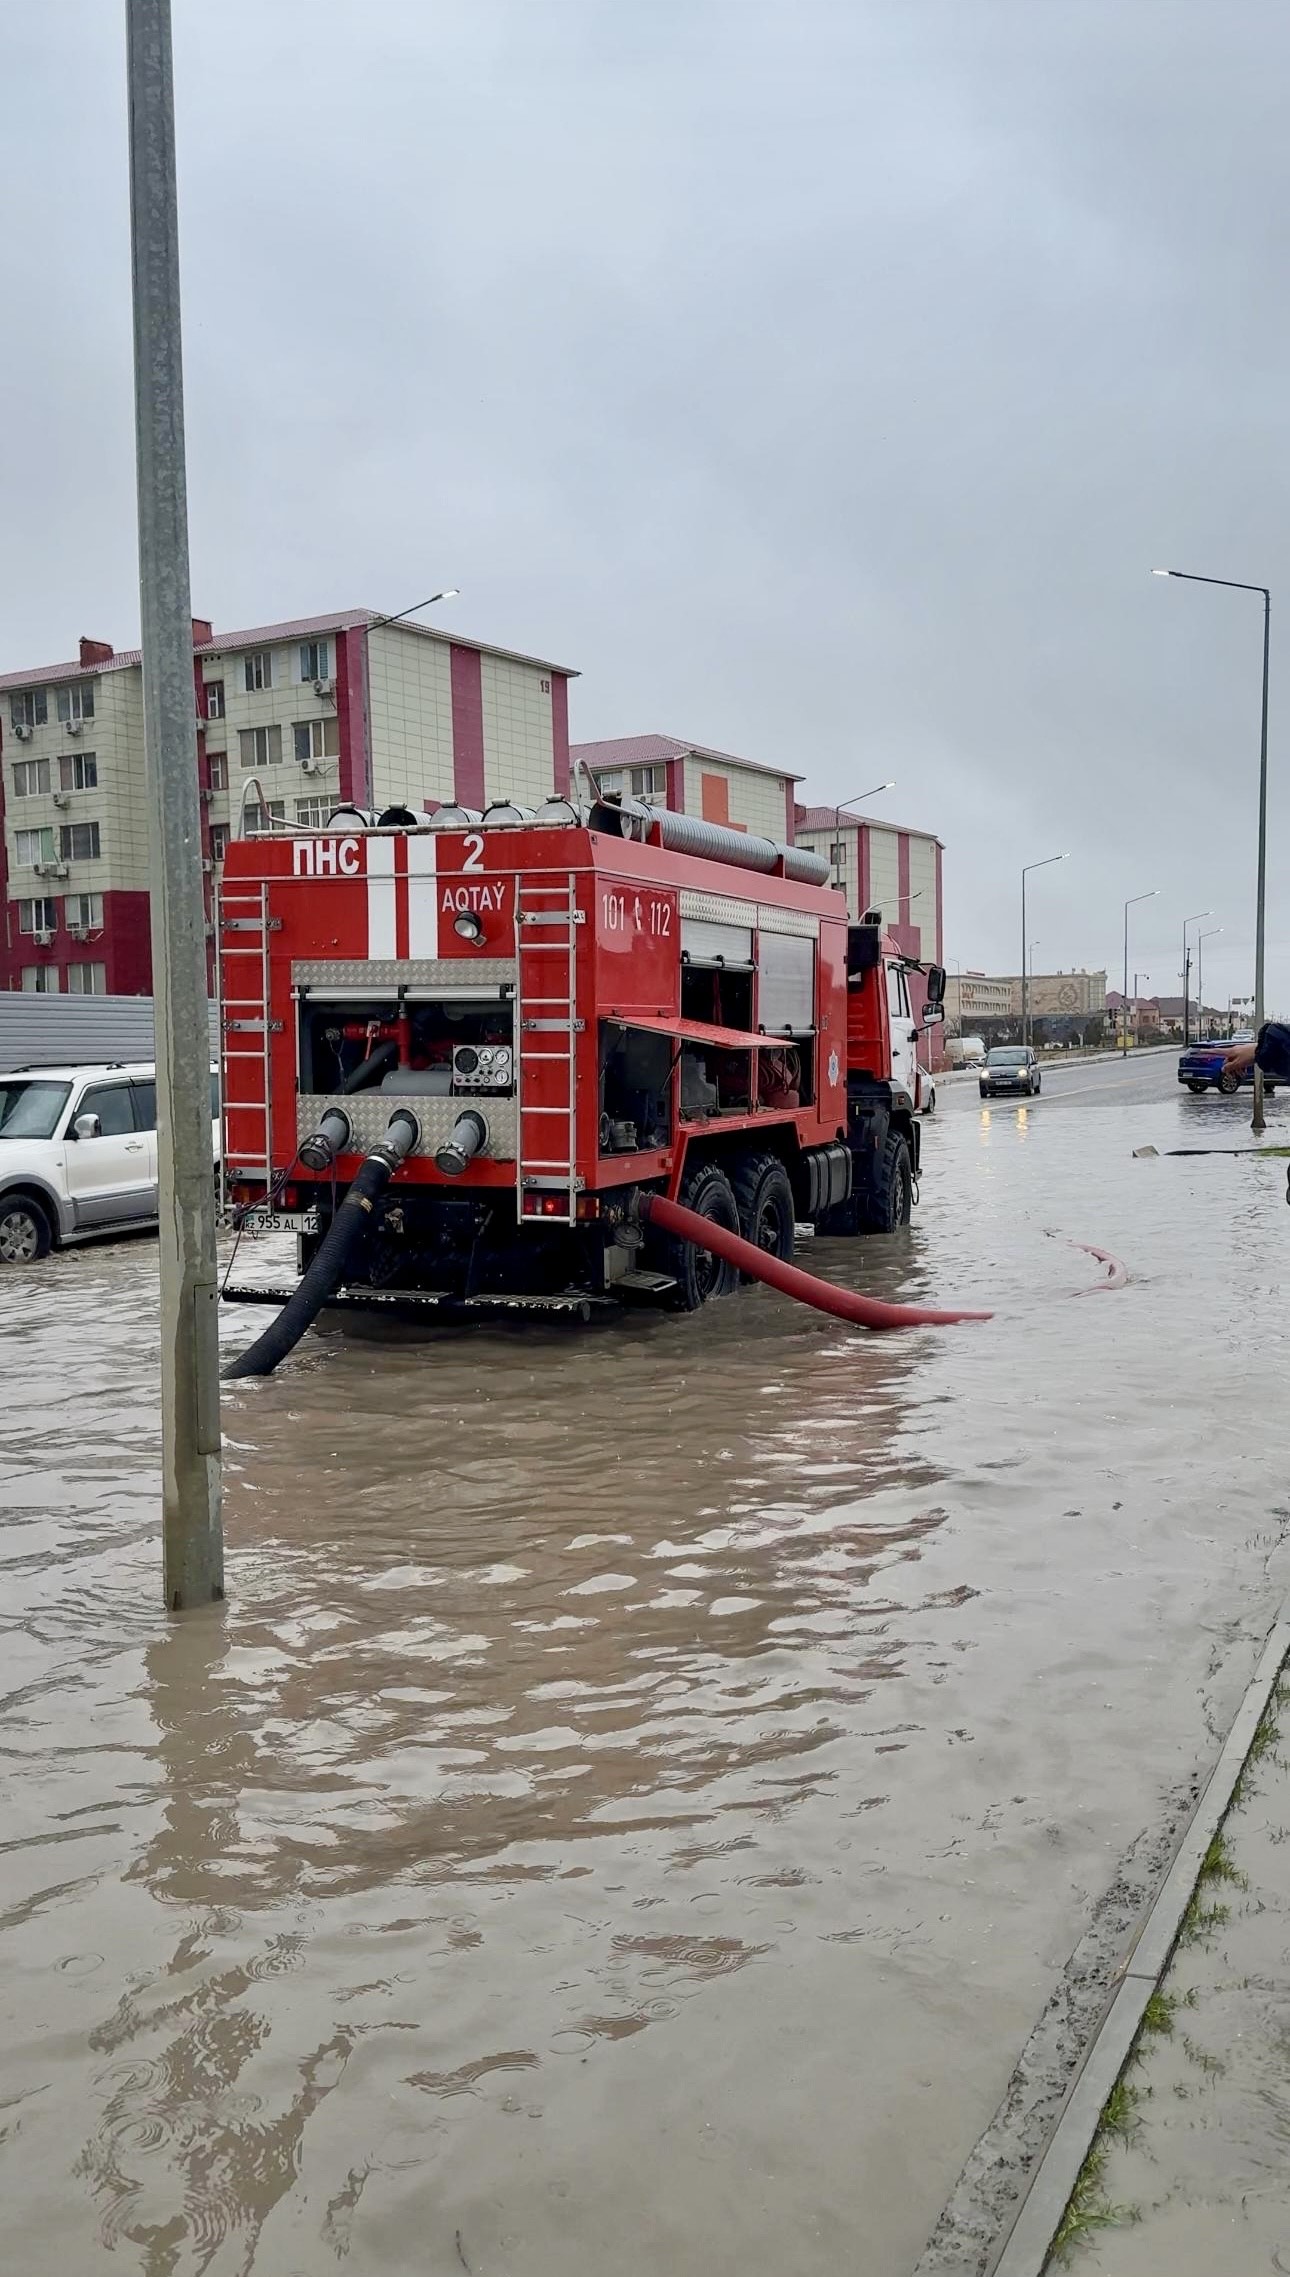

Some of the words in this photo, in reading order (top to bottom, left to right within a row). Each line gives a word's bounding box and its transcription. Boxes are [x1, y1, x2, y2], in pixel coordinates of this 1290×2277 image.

[540, 680, 550, 694] 19
[293, 838, 360, 876] ПНС
[462, 834, 485, 872] 2
[441, 881, 506, 912] AQTAÝ
[602, 894, 625, 931] 101
[650, 901, 670, 937] 112
[257, 1215, 281, 1229] 955
[283, 1218, 298, 1230] AL
[303, 1216, 318, 1230] 12
